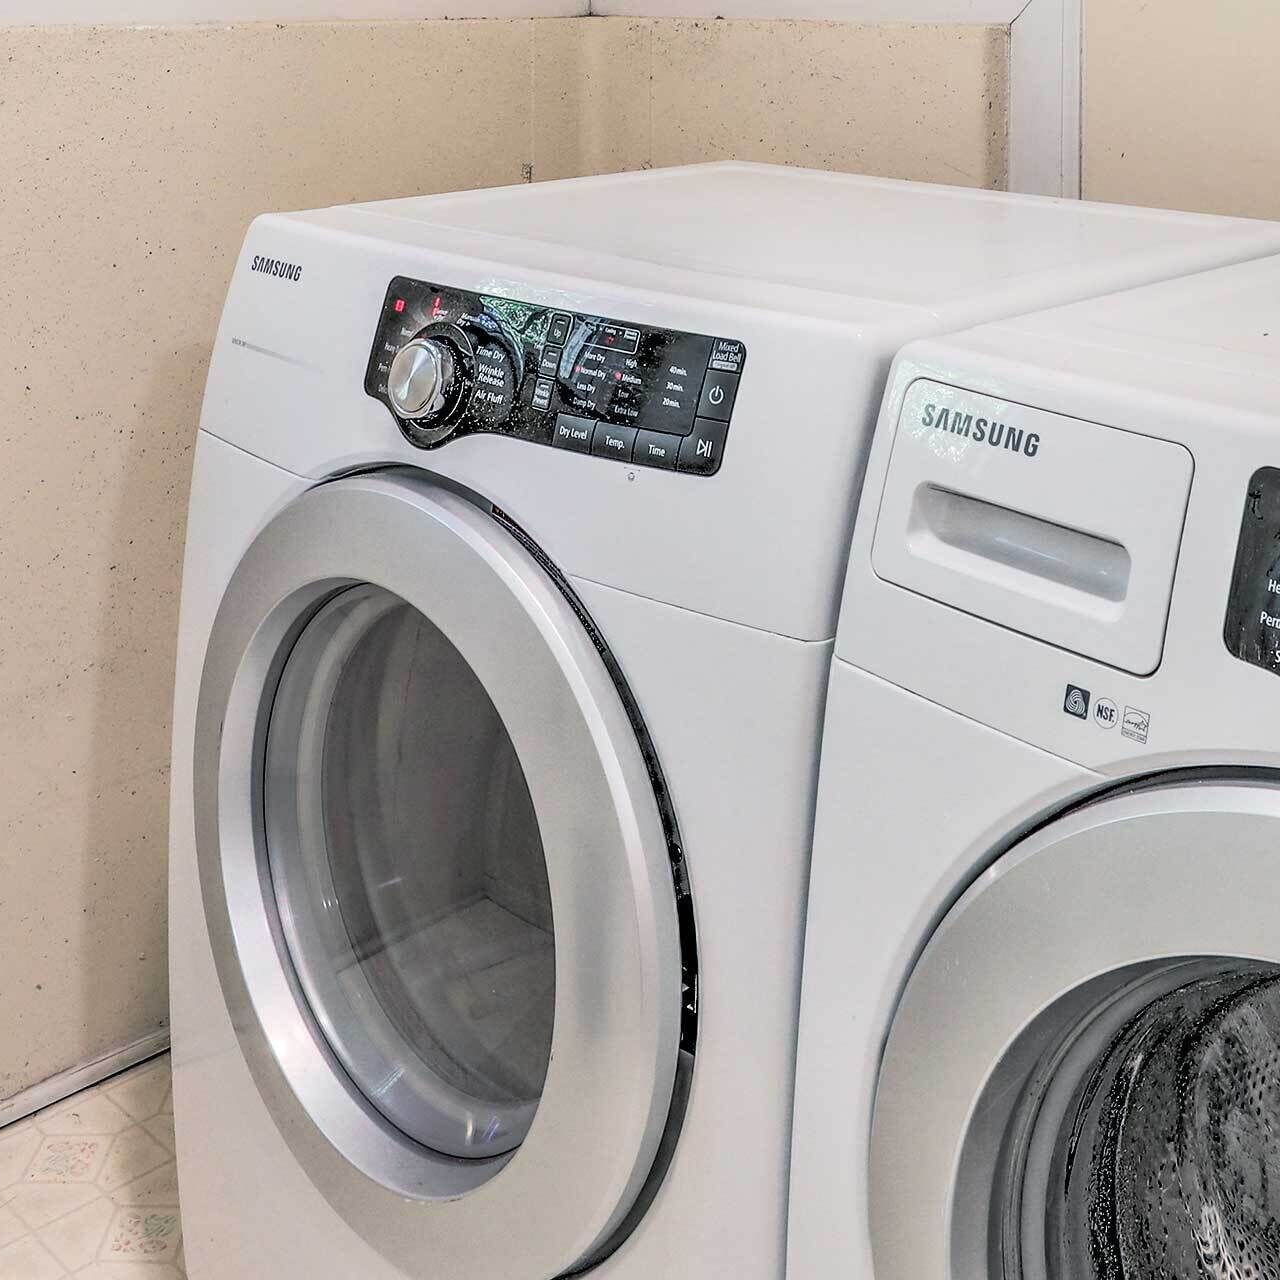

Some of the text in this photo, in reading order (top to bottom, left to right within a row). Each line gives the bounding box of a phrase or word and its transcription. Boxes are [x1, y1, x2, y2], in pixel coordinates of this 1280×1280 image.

[251, 255, 302, 282] SAMSUNG
[719, 341, 740, 353] Mixed
[476, 346, 505, 362] Time Dry
[597, 354, 606, 364] Dry
[712, 350, 742, 363] Load Bell
[542, 359, 557, 370] Down
[625, 359, 638, 369] High
[478, 363, 505, 379] Wrinkle
[596, 370, 607, 380] Dry
[478, 373, 505, 388] Release
[622, 373, 642, 385] Medium
[576, 381, 596, 393] Less Dry
[474, 389, 504, 404] Air Fluff
[618, 389, 629, 399] Low
[586, 400, 596, 410] Dry
[627, 407, 639, 417] Low
[559, 425, 588, 440] Dry Level
[921, 403, 1041, 458] SAMSUNG
[605, 435, 625, 449] Temp.
[648, 444, 666, 457] Time
